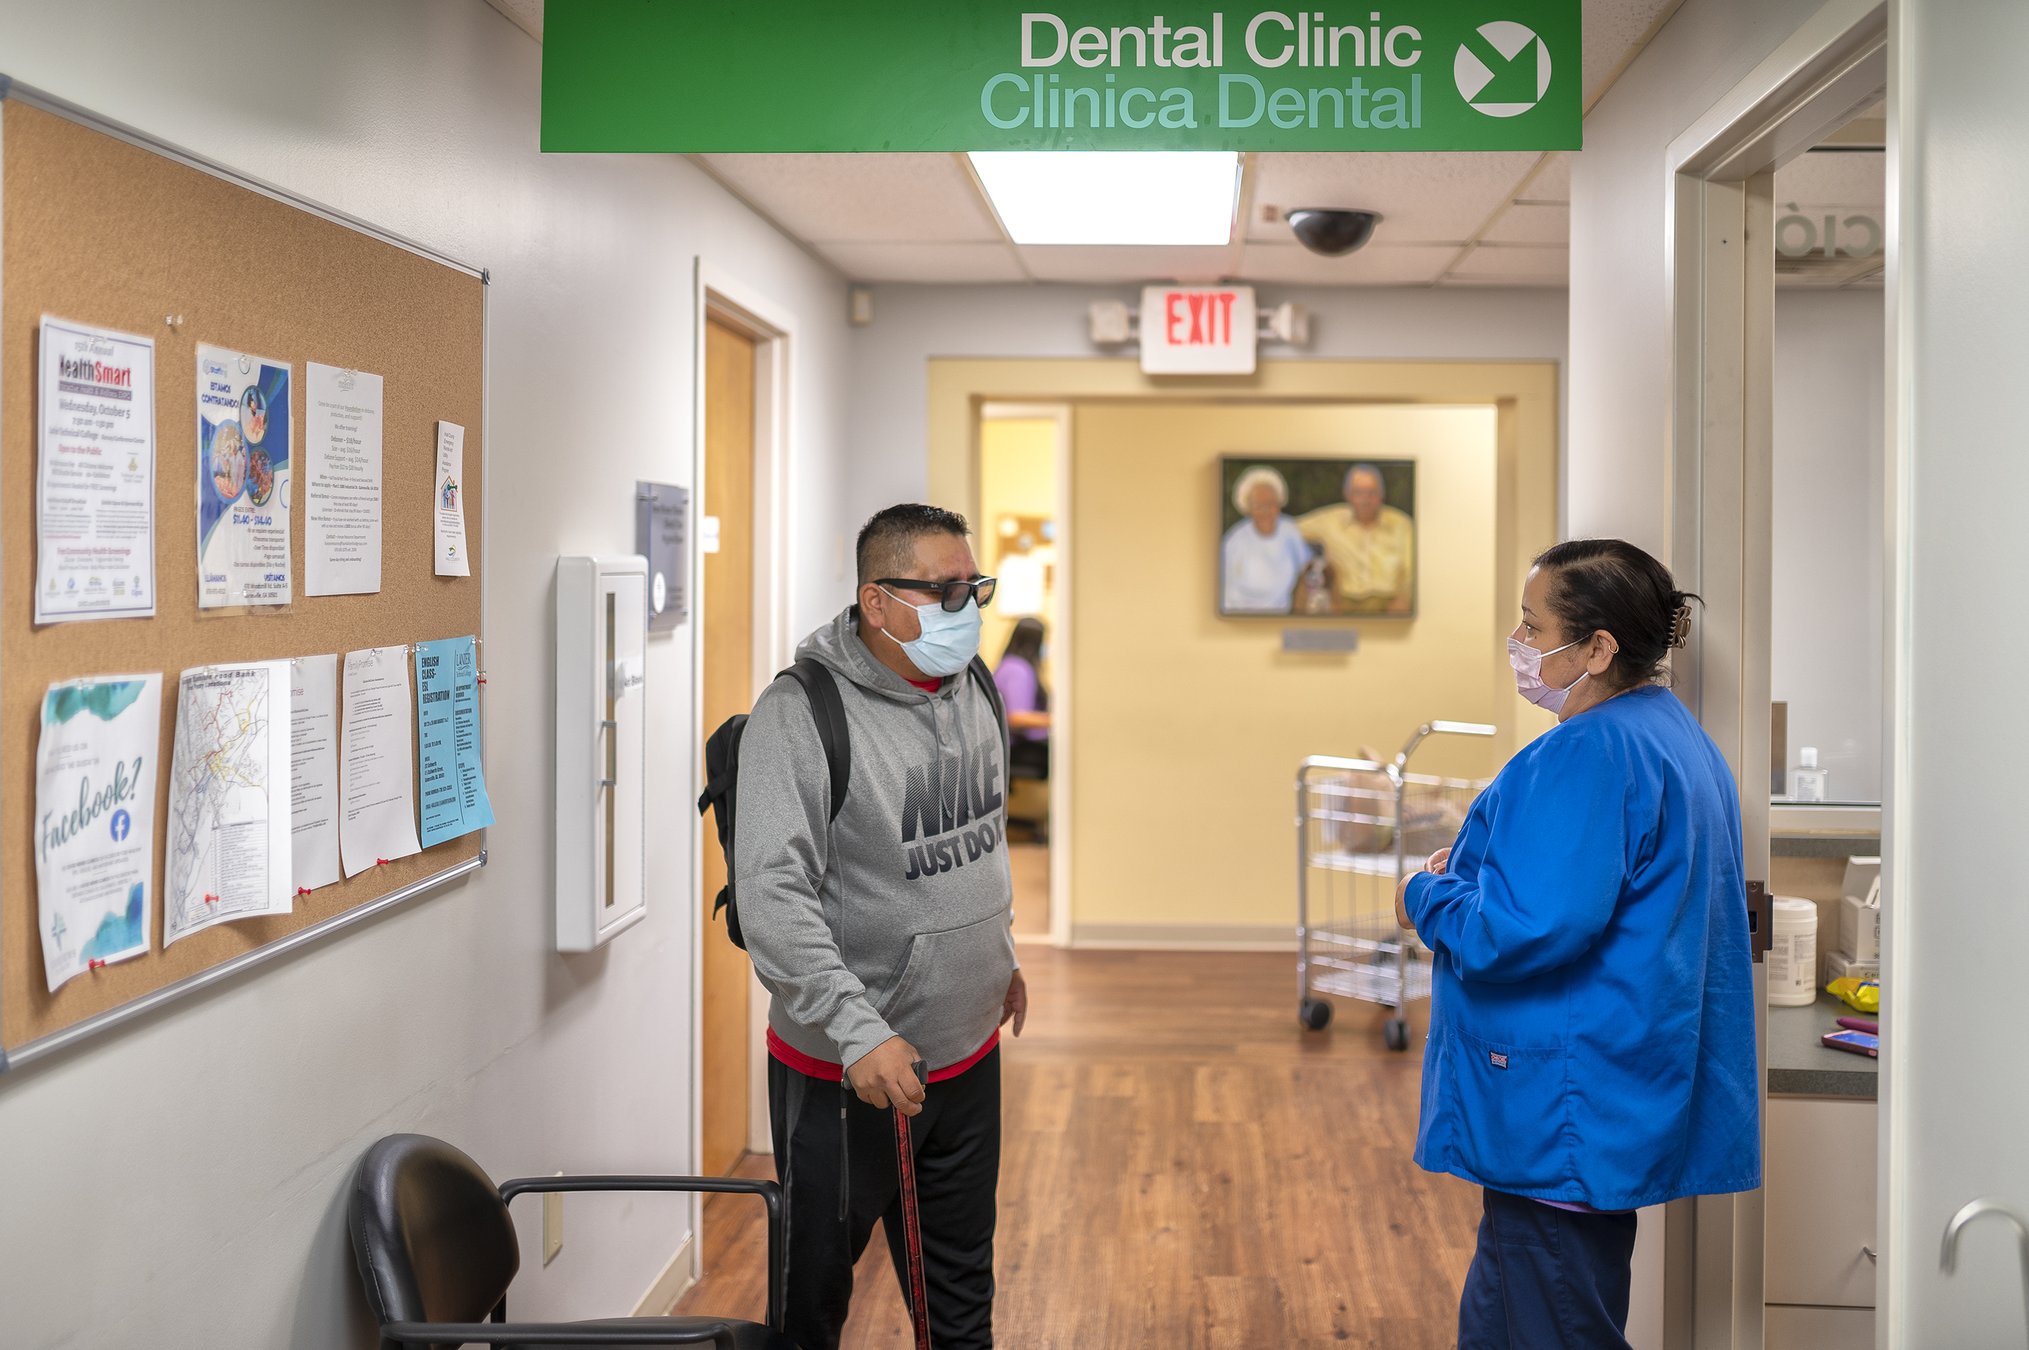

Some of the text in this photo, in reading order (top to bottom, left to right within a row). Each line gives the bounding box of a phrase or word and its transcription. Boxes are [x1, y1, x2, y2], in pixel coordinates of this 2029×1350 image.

[1020, 11, 1422, 68] Dental Clinic
[980, 72, 1422, 129] Clinica Dental
[1166, 293, 1236, 345] EXIT
[59, 354, 132, 388] HealthSmart
[98, 404, 126, 416] October
[422, 655, 440, 668] ENGLISH
[422, 690, 450, 704] REGISTRATION
[42, 756, 142, 864] Facebook?
[901, 740, 1002, 844] NIKE
[905, 835, 964, 880] JUST
[962, 822, 995, 863] DO
